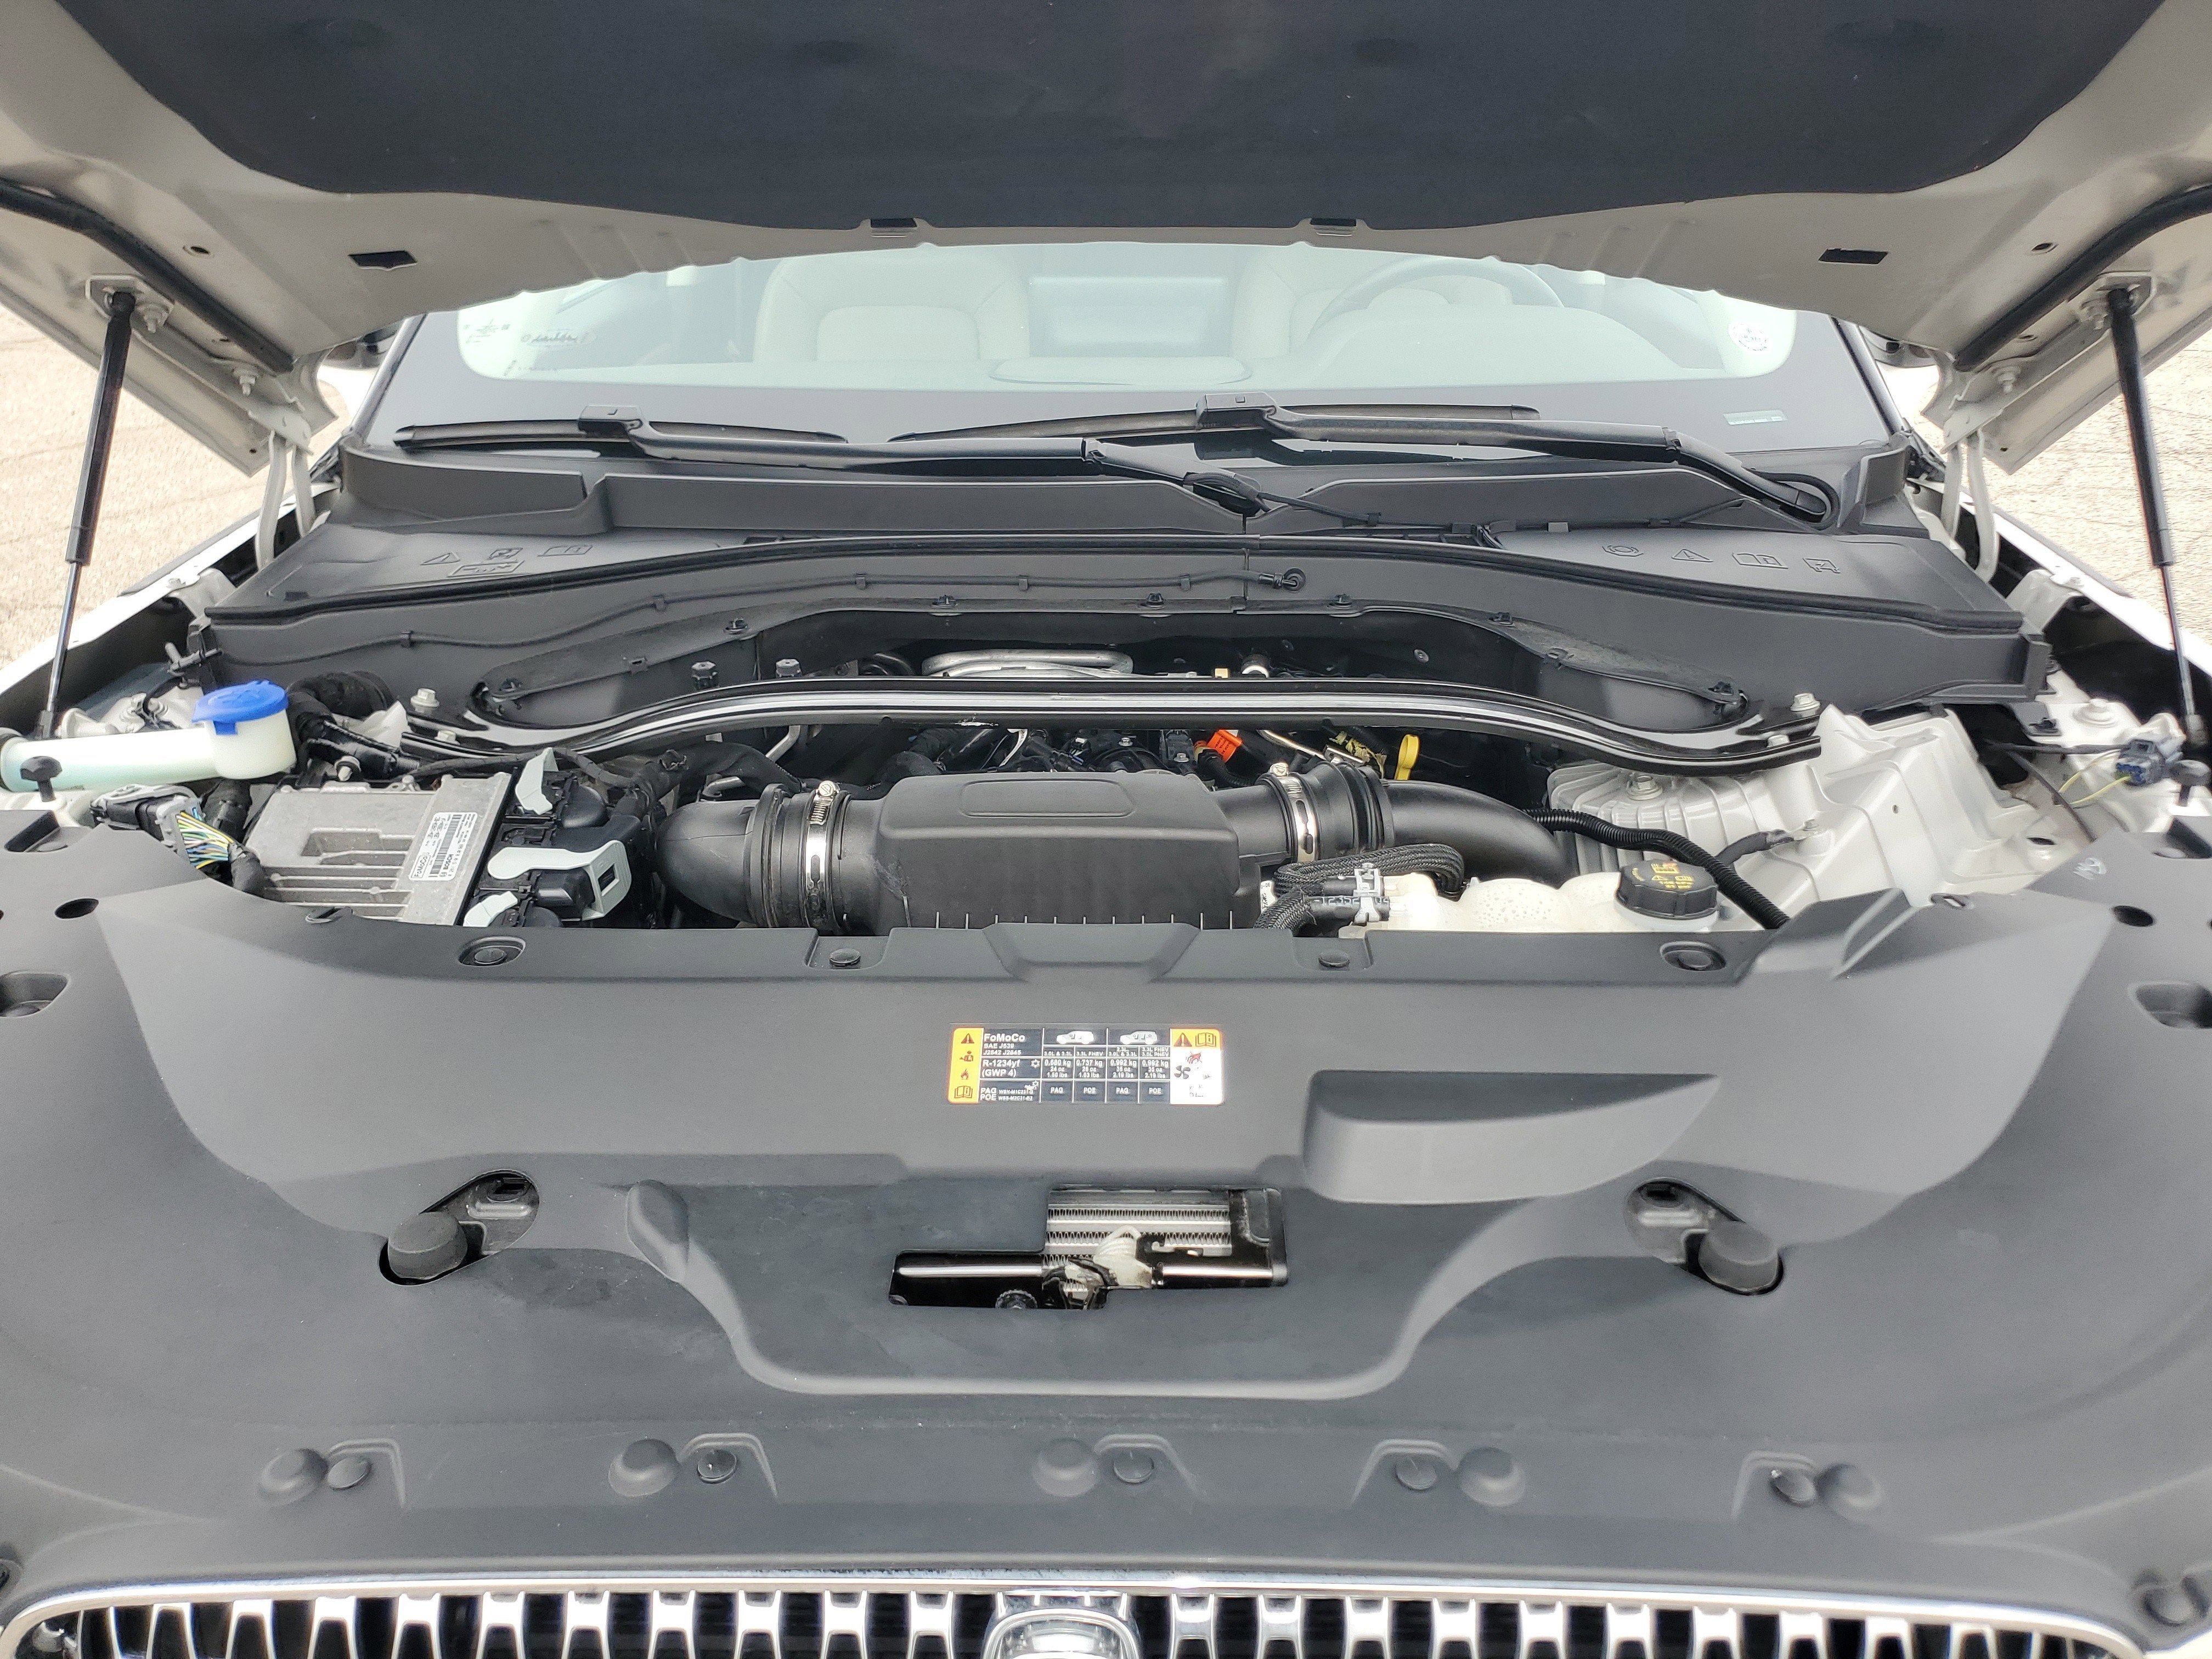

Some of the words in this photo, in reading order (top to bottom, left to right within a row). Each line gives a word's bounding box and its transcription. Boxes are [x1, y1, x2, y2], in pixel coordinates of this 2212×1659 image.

[984, 1033, 1025, 1042] FoMoCo
[983, 1059, 1020, 1068] R-1234yf
[1063, 1059, 1071, 1068] kg
[1094, 1059, 1103, 1068] kg
[1129, 1059, 1137, 1068] kg
[1161, 1059, 1169, 1068] kg
[982, 1069, 1007, 1077] (GWP
[1008, 1069, 1017, 1077] 4)
